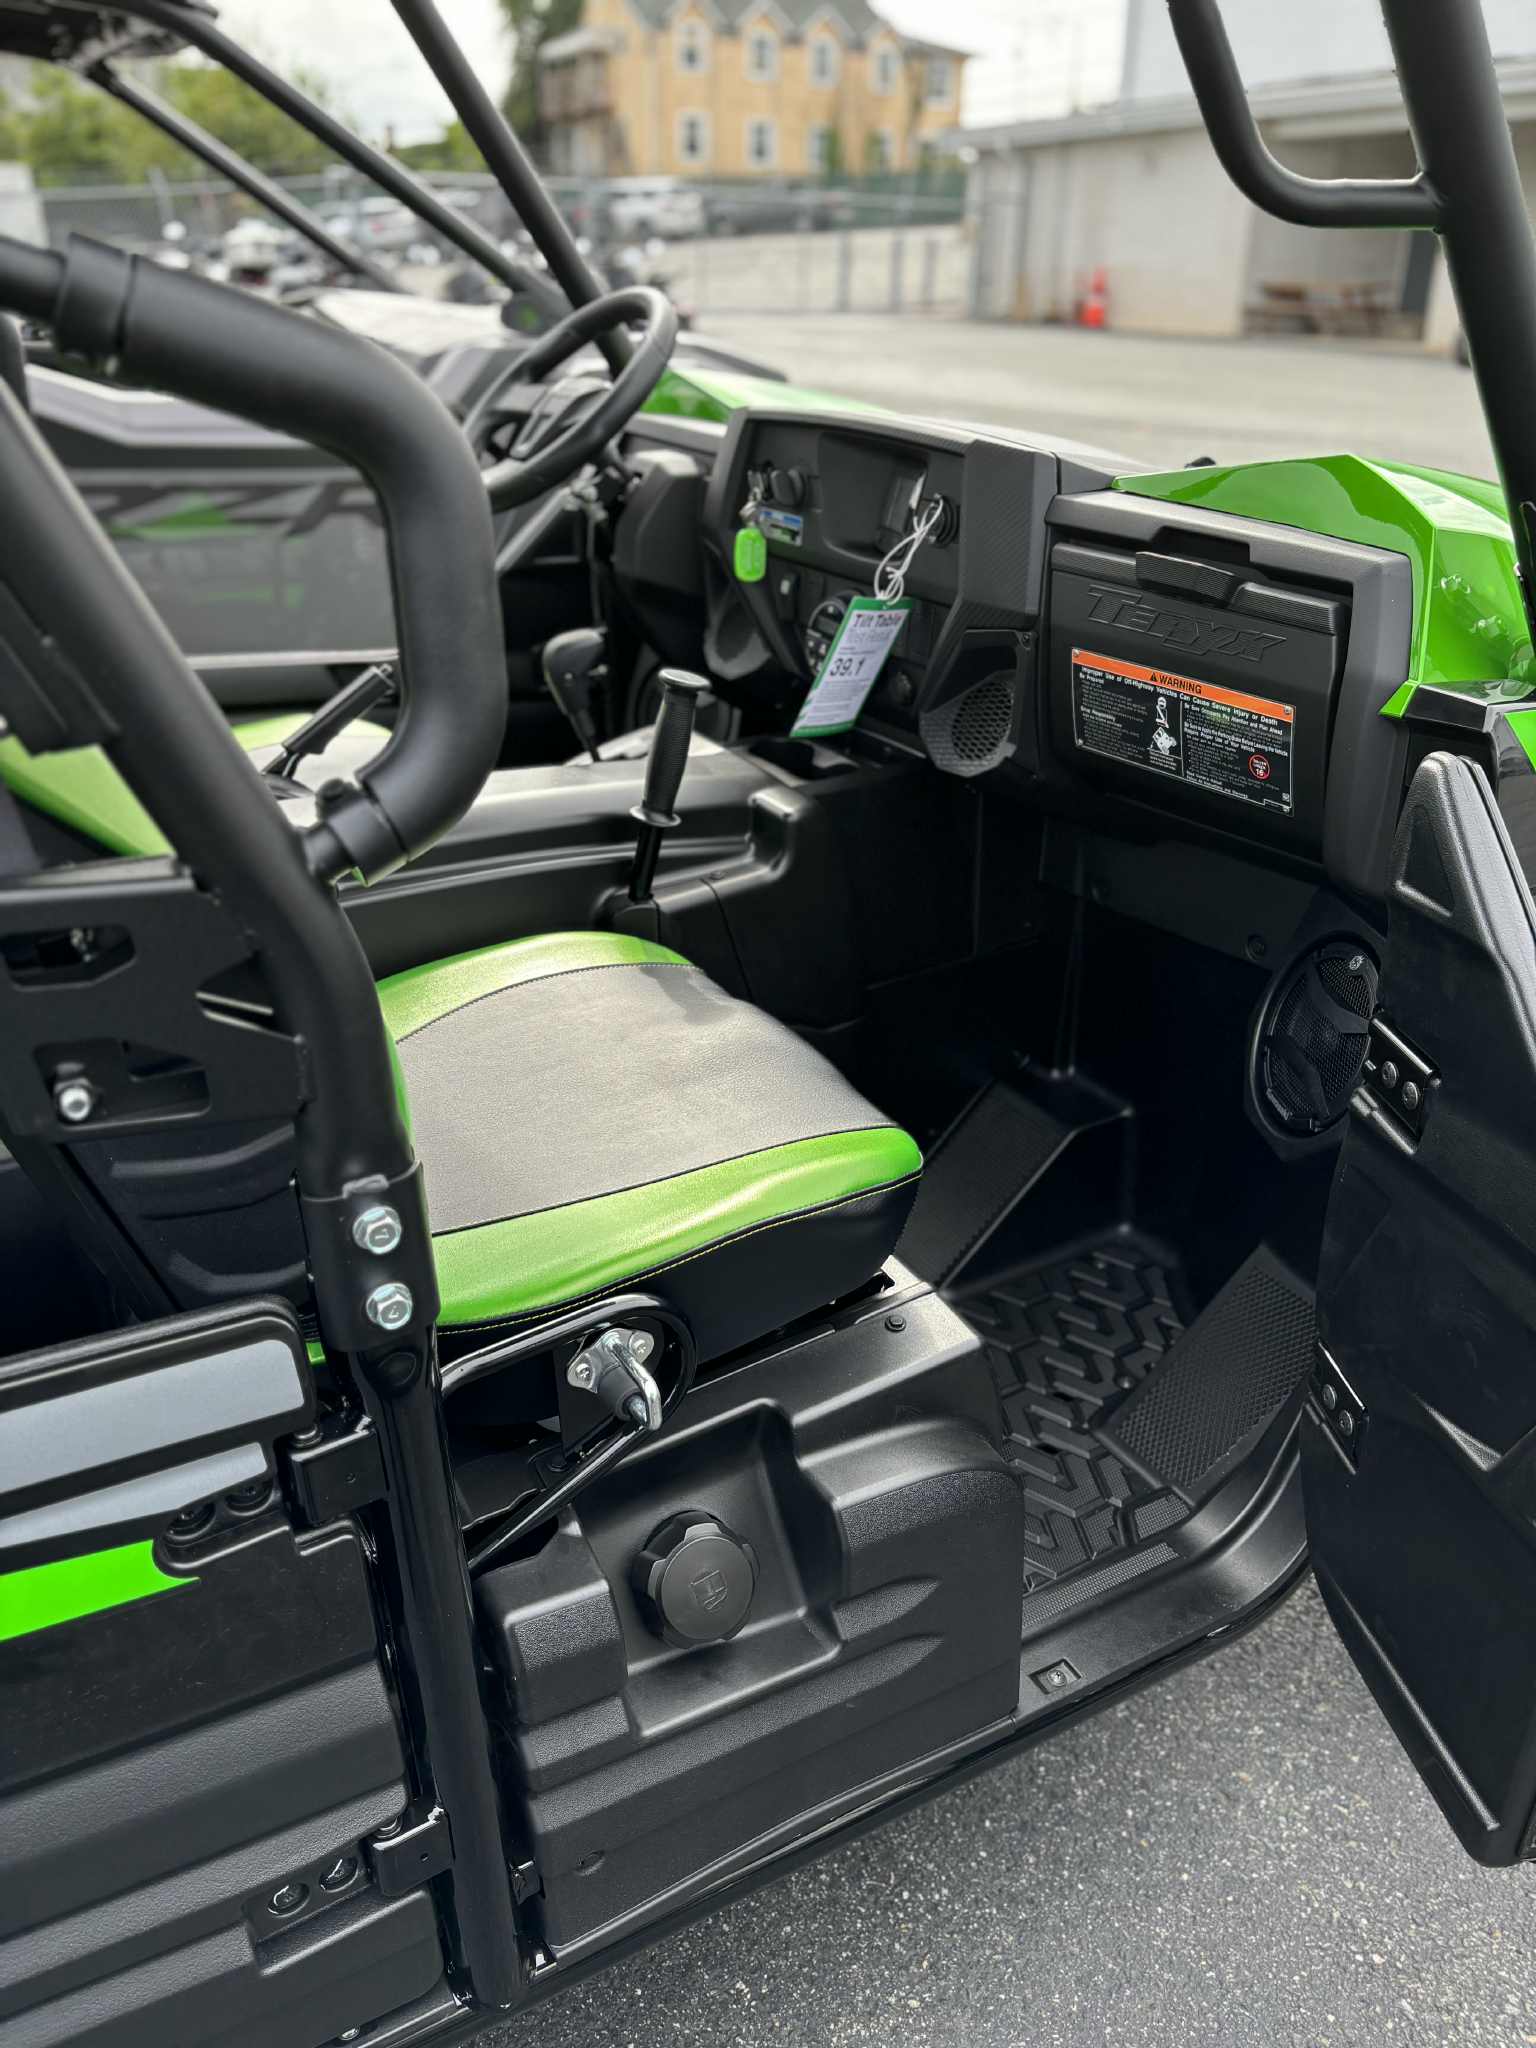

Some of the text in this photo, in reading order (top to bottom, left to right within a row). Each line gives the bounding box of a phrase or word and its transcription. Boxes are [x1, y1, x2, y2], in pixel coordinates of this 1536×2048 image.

[874, 613, 902, 628] Table
[1087, 584, 1288, 662] TERYX
[830, 656, 866, 676] 39.1
[1159, 674, 1202, 695] WARNING
[1156, 686, 1178, 698] Vehicles
[1180, 692, 1190, 702] Can
[1192, 696, 1210, 707] Cause
[1212, 702, 1230, 713] Severe
[1234, 707, 1249, 719] Injury
[1260, 715, 1278, 726] Death
